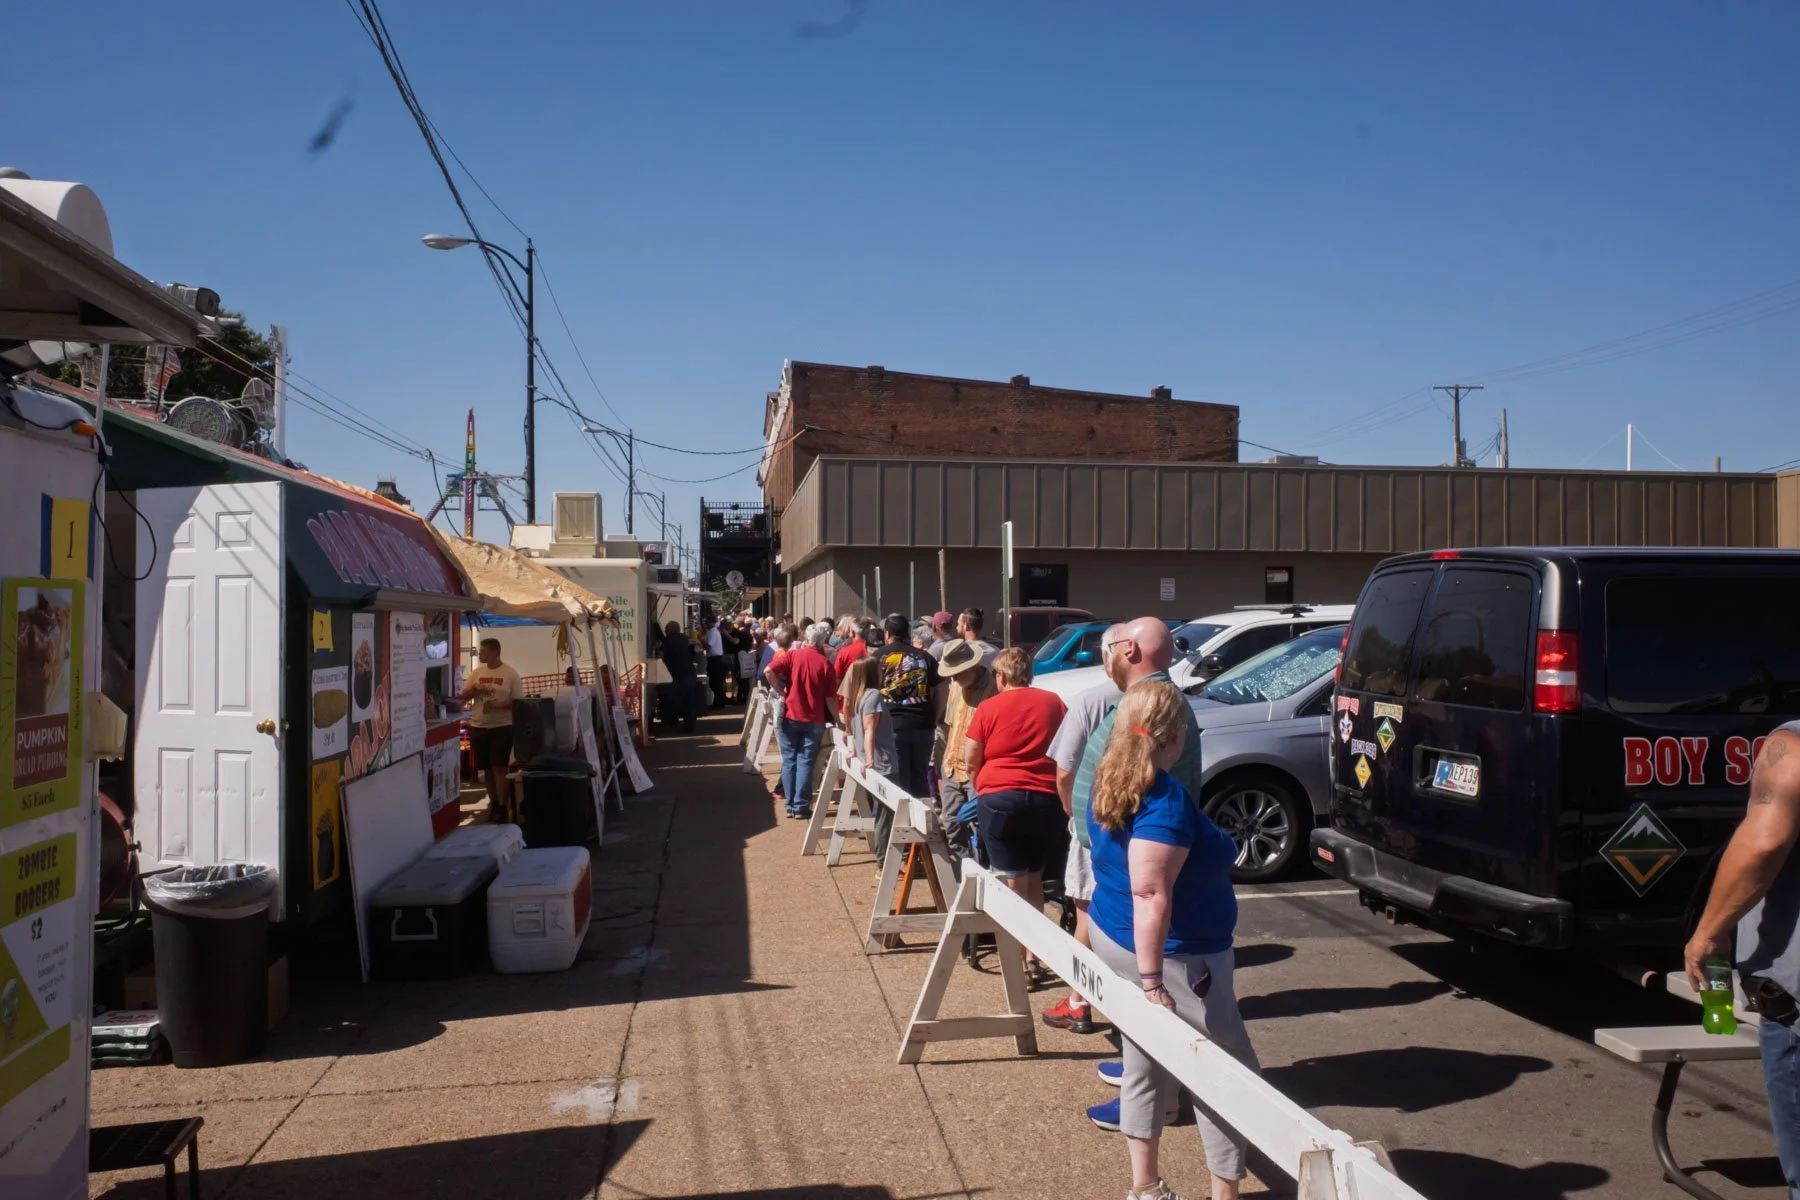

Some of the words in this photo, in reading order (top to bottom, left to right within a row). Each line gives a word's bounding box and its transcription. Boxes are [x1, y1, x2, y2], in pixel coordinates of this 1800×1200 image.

[66, 519, 74, 559] 1
[16, 725, 66, 750] PUMPKIN
[1623, 736, 1709, 786] BOY
[33, 788, 55, 808] Each
[18, 844, 58, 880] ZOMBIE
[31, 917, 43, 941] $2
[1072, 954, 1103, 1001] WSNC
